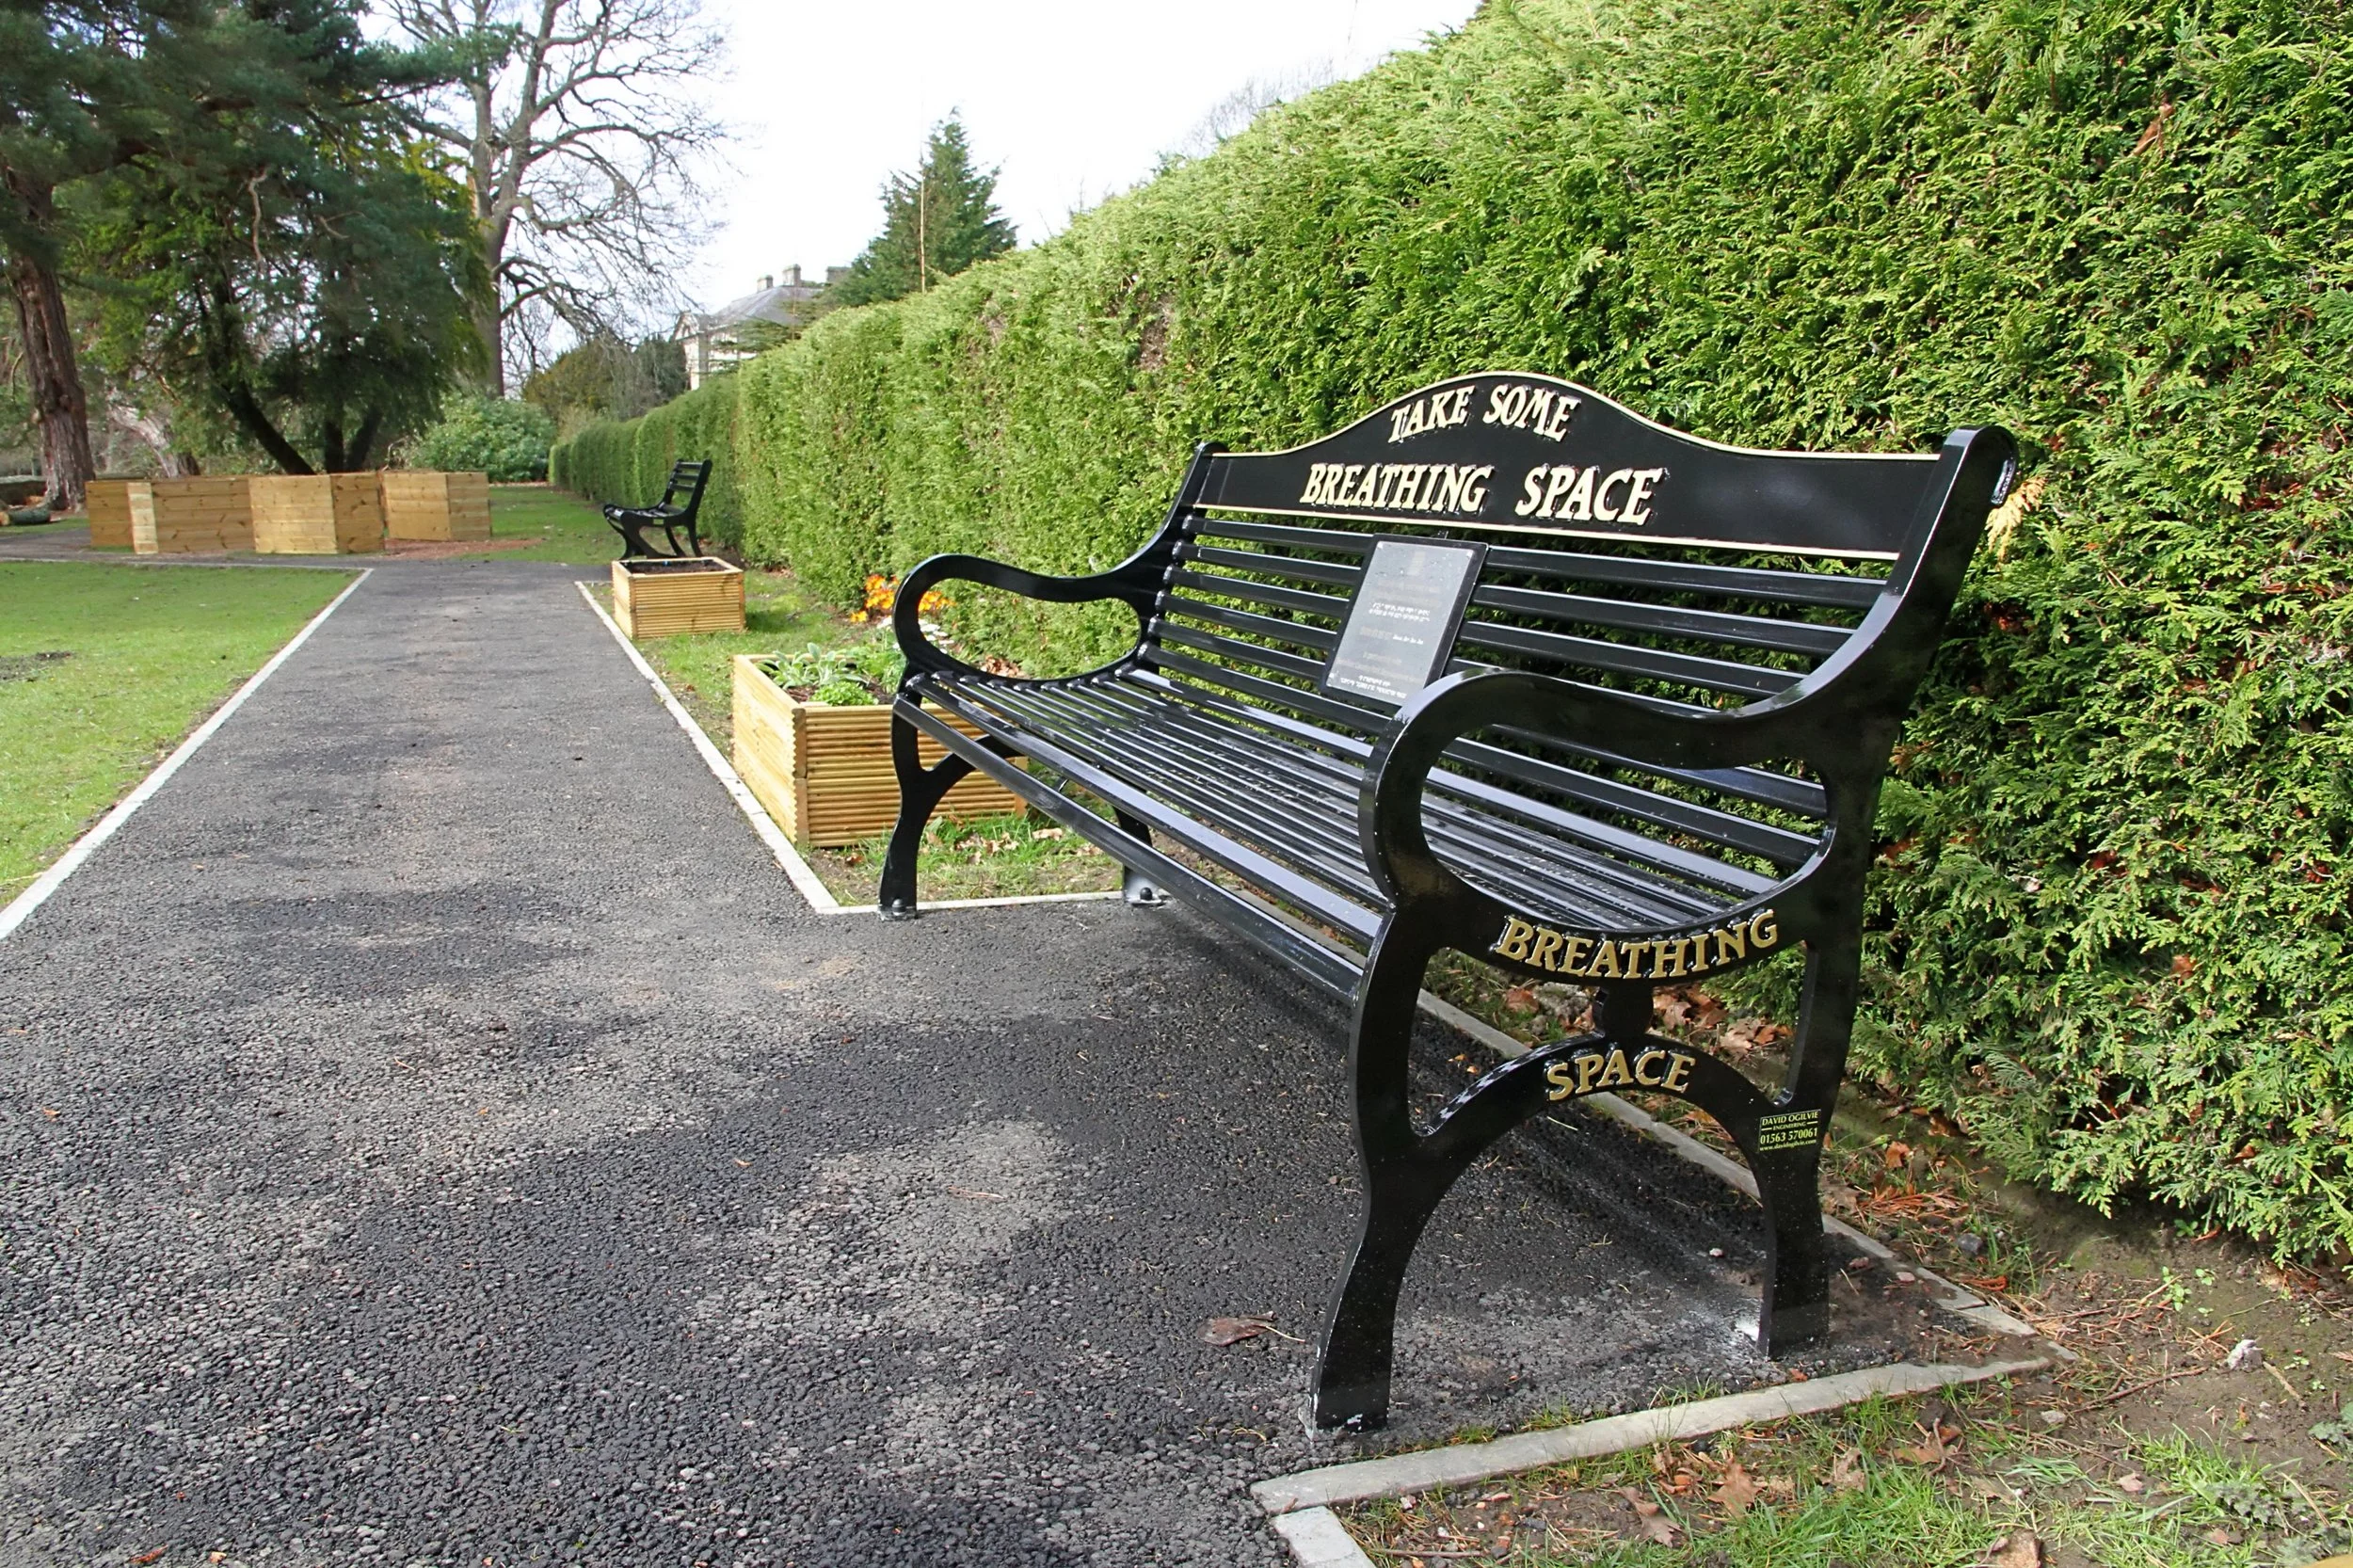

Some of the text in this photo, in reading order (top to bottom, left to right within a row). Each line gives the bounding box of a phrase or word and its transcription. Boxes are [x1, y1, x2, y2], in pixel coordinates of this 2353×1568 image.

[1388, 384, 1579, 443] TAKE SOME
[1300, 463, 1664, 525] BREATHING SPACE
[1496, 910, 1778, 980] BREATHING
[1547, 1049, 1696, 1100] SPACE
[1760, 1128, 1817, 1144] 01563 570061
[1762, 1112, 1818, 1126] DAVID OGILVIE
[1773, 1122, 1806, 1130] ENGINEERING
